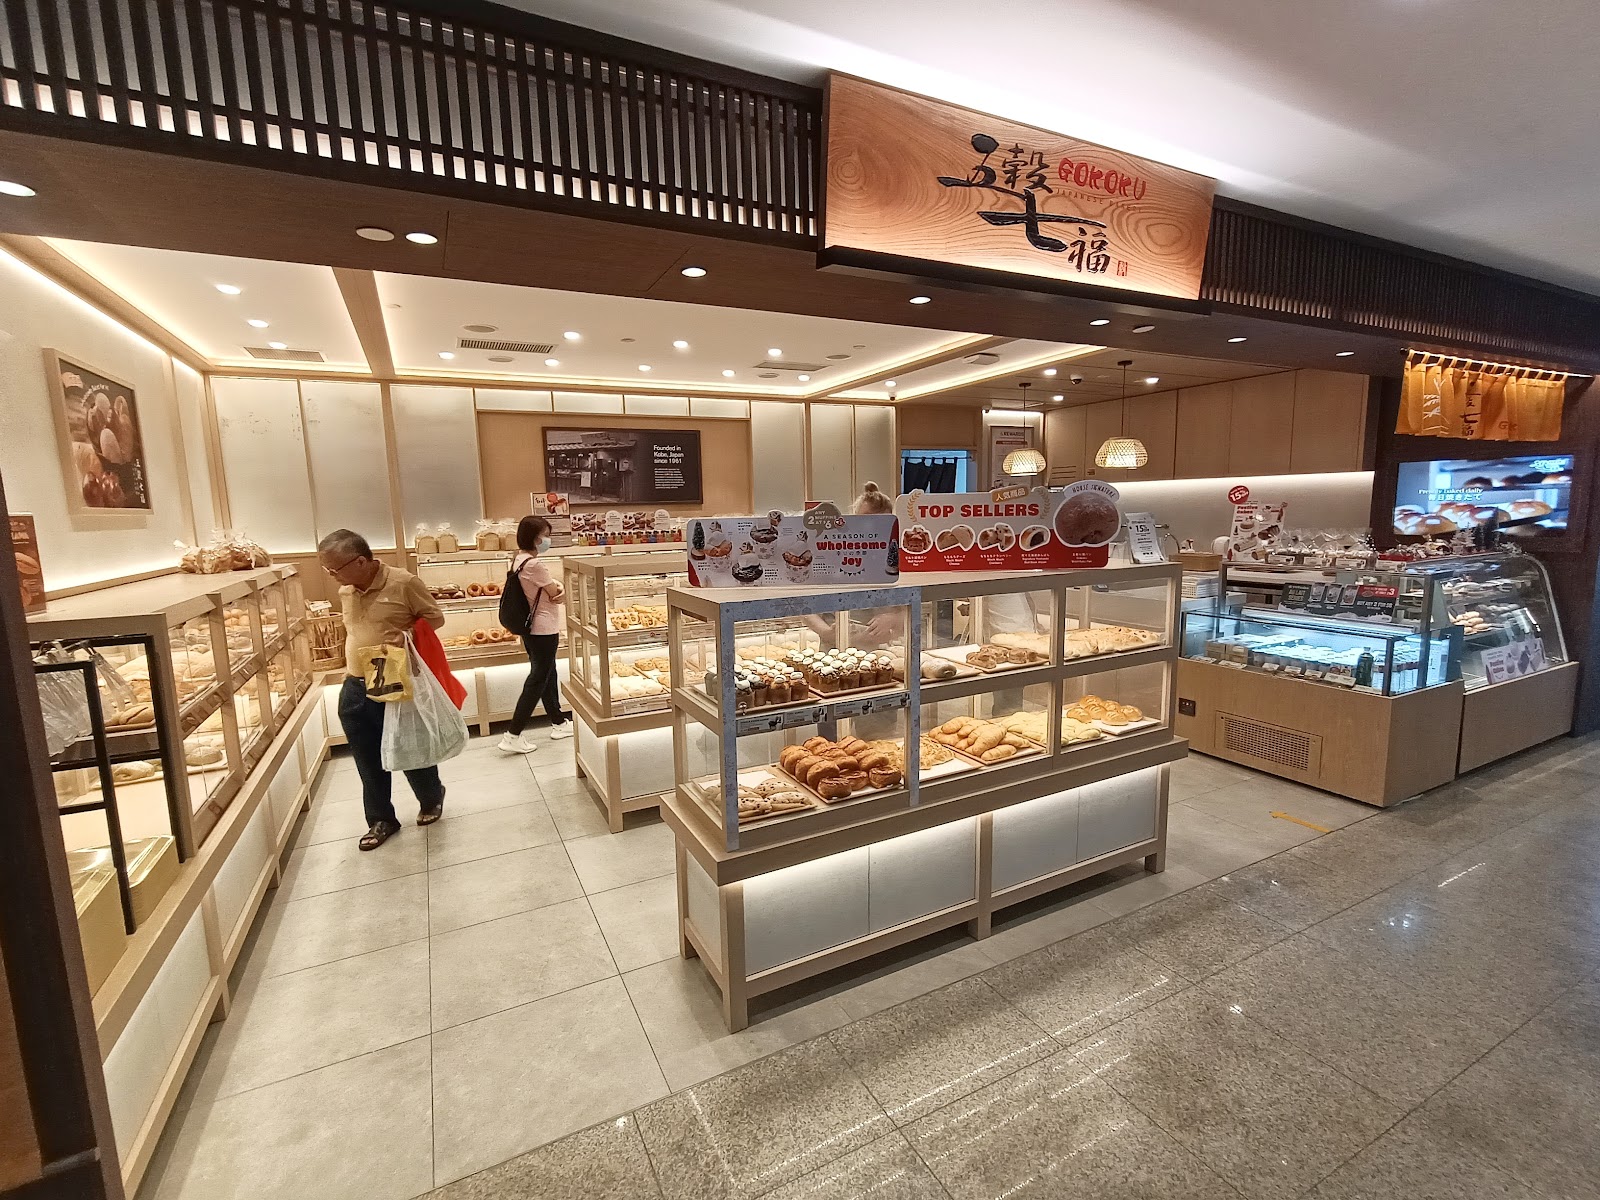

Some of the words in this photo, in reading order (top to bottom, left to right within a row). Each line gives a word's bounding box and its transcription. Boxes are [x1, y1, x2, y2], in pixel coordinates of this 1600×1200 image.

[1058, 157, 1147, 200] GOKOKU
[1055, 188, 1103, 205] JAPANESE
[995, 487, 1026, 502] 人気商品
[1072, 484, 1089, 493] HOUSE
[1091, 484, 1116, 498] SIGNATURE
[1465, 487, 1484, 495] daily
[918, 505, 955, 518] TOP
[960, 503, 1040, 518] SELLERS
[808, 516, 815, 524] 2
[816, 541, 887, 551] Wholesome
[841, 556, 863, 568] Joy
